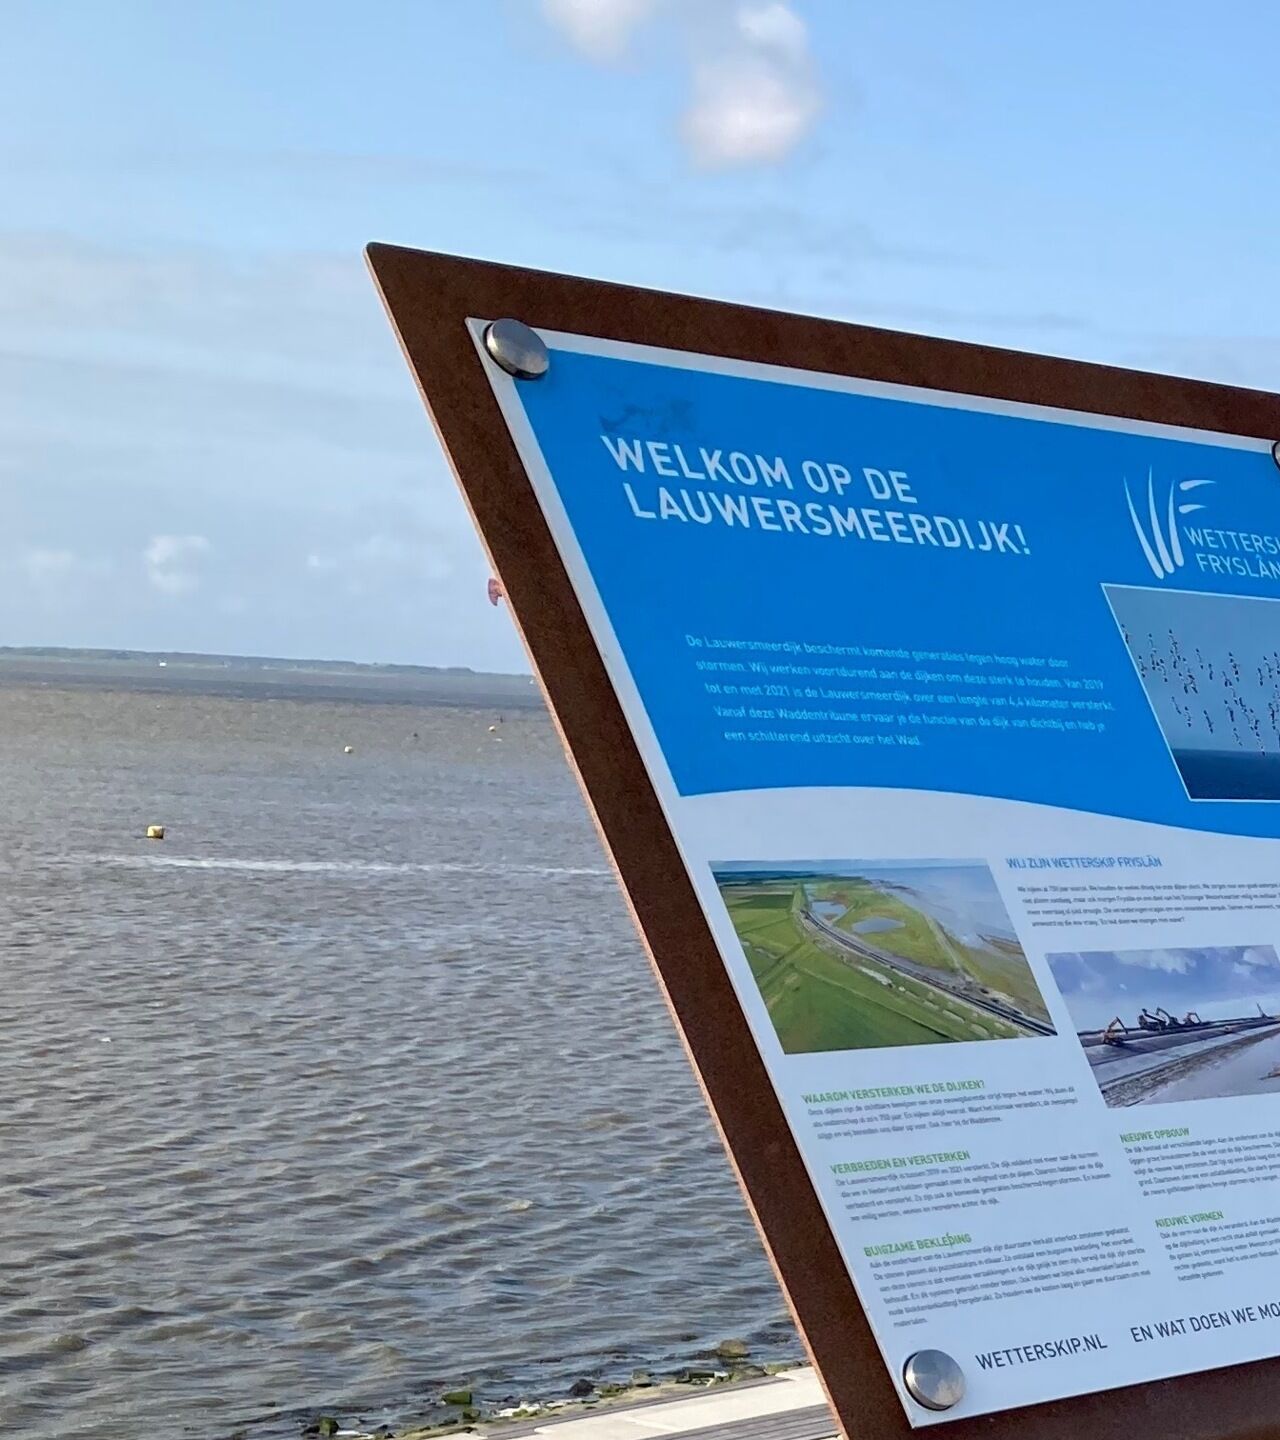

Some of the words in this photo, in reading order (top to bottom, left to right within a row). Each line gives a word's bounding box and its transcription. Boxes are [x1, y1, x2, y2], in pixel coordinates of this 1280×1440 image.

[602, 436, 793, 489] WELKOM
[802, 460, 851, 495] OP
[863, 468, 917, 503] DE
[624, 483, 1030, 554] LAUWERSMEERDIJK!
[802, 1091, 849, 1104] WAAROM
[849, 1086, 915, 1099] VERSTERKEN
[915, 1084, 932, 1094] WE
[932, 1082, 945, 1093] DE
[946, 1080, 984, 1091] DIJKEN?
[1120, 1131, 1154, 1143] NIEUWE
[1154, 1127, 1189, 1139] OPBOUW
[831, 1159, 892, 1174] VERBREDEN
[892, 1157, 907, 1168] EN
[907, 1150, 970, 1165] VERSTERKEN
[1155, 1215, 1189, 1228] NIEUWE
[1189, 1211, 1224, 1223] VORMEN
[864, 1241, 916, 1257] BUIGZAME
[1131, 1325, 1154, 1342] EN
[1154, 1318, 1186, 1338] WAT
[1189, 1311, 1231, 1332] DOEN
[1231, 1307, 1257, 1323] WE
[976, 1334, 1106, 1370] WETTERSKIP.NL
